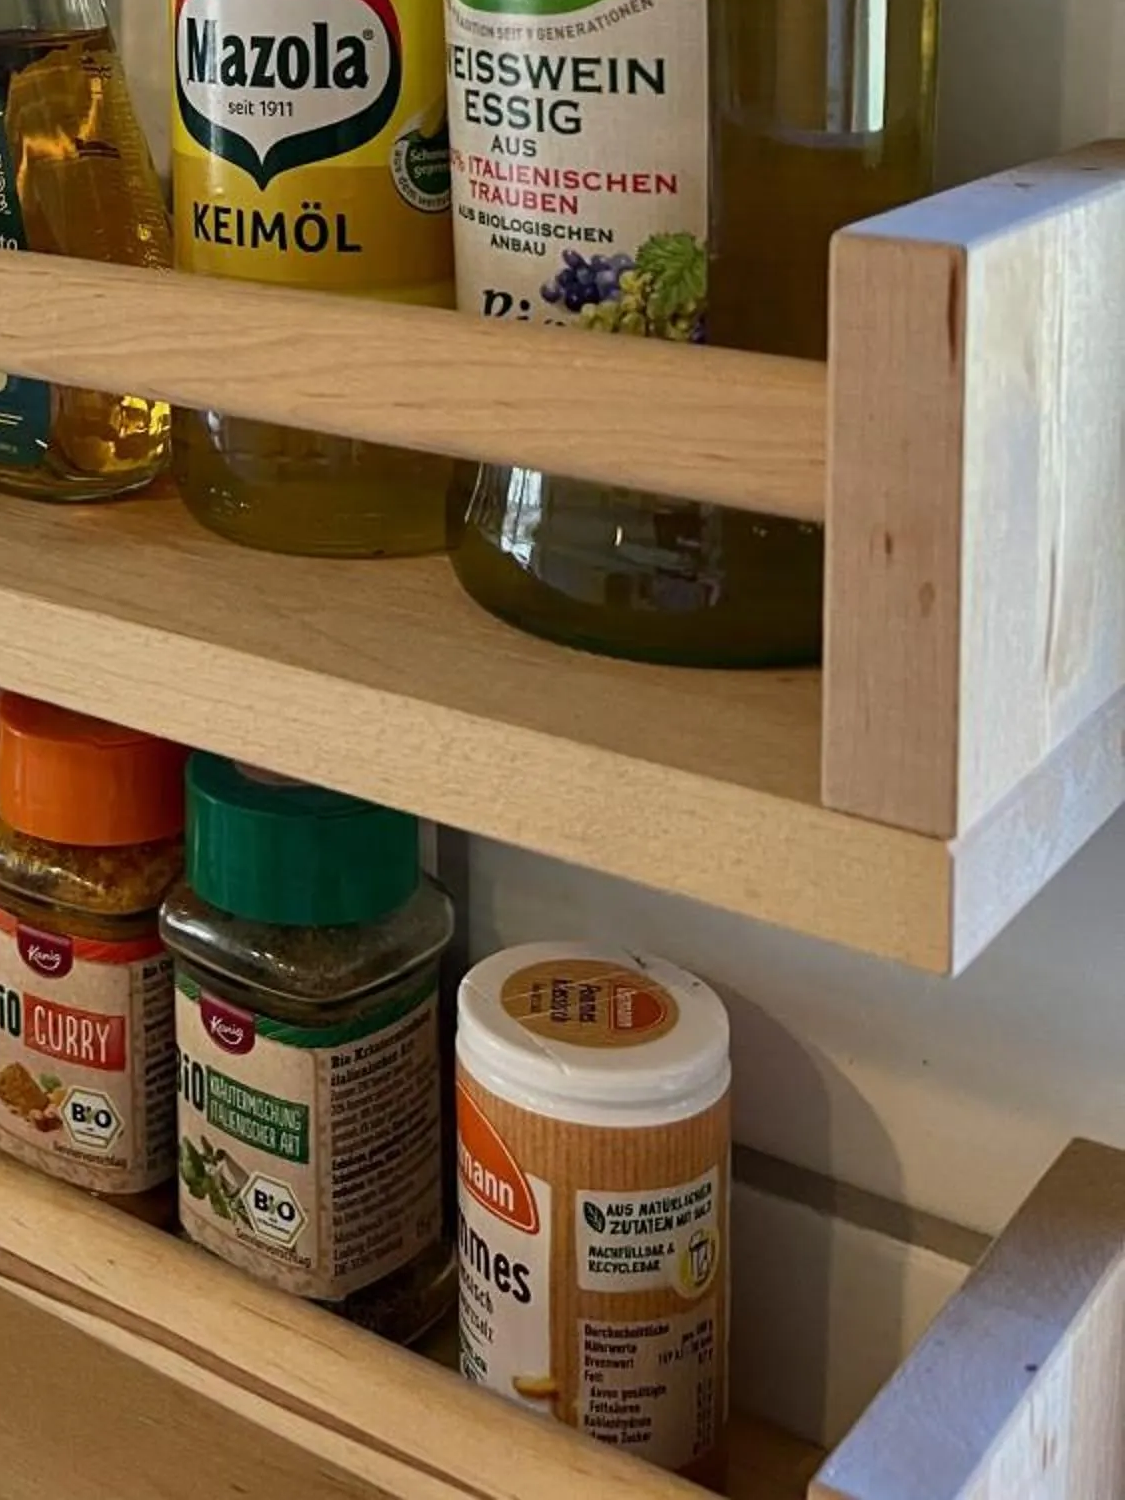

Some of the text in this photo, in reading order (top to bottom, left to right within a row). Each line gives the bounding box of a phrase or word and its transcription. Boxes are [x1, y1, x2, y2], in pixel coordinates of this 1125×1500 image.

[227, 100, 294, 117] seit 1911
[464, 88, 583, 135] ESSIG
[490, 134, 537, 158] AUS
[468, 155, 679, 195] ITALIENISCHEN
[469, 179, 579, 216] TRAUBEN
[193, 200, 362, 254] KEIMÖL
[490, 233, 547, 257] ANBAU
[33, 1004, 111, 1064] CURRY
[175, 1043, 204, 1113] iO
[606, 1202, 635, 1218] AUS
[609, 1214, 675, 1236] ZUTATEN
